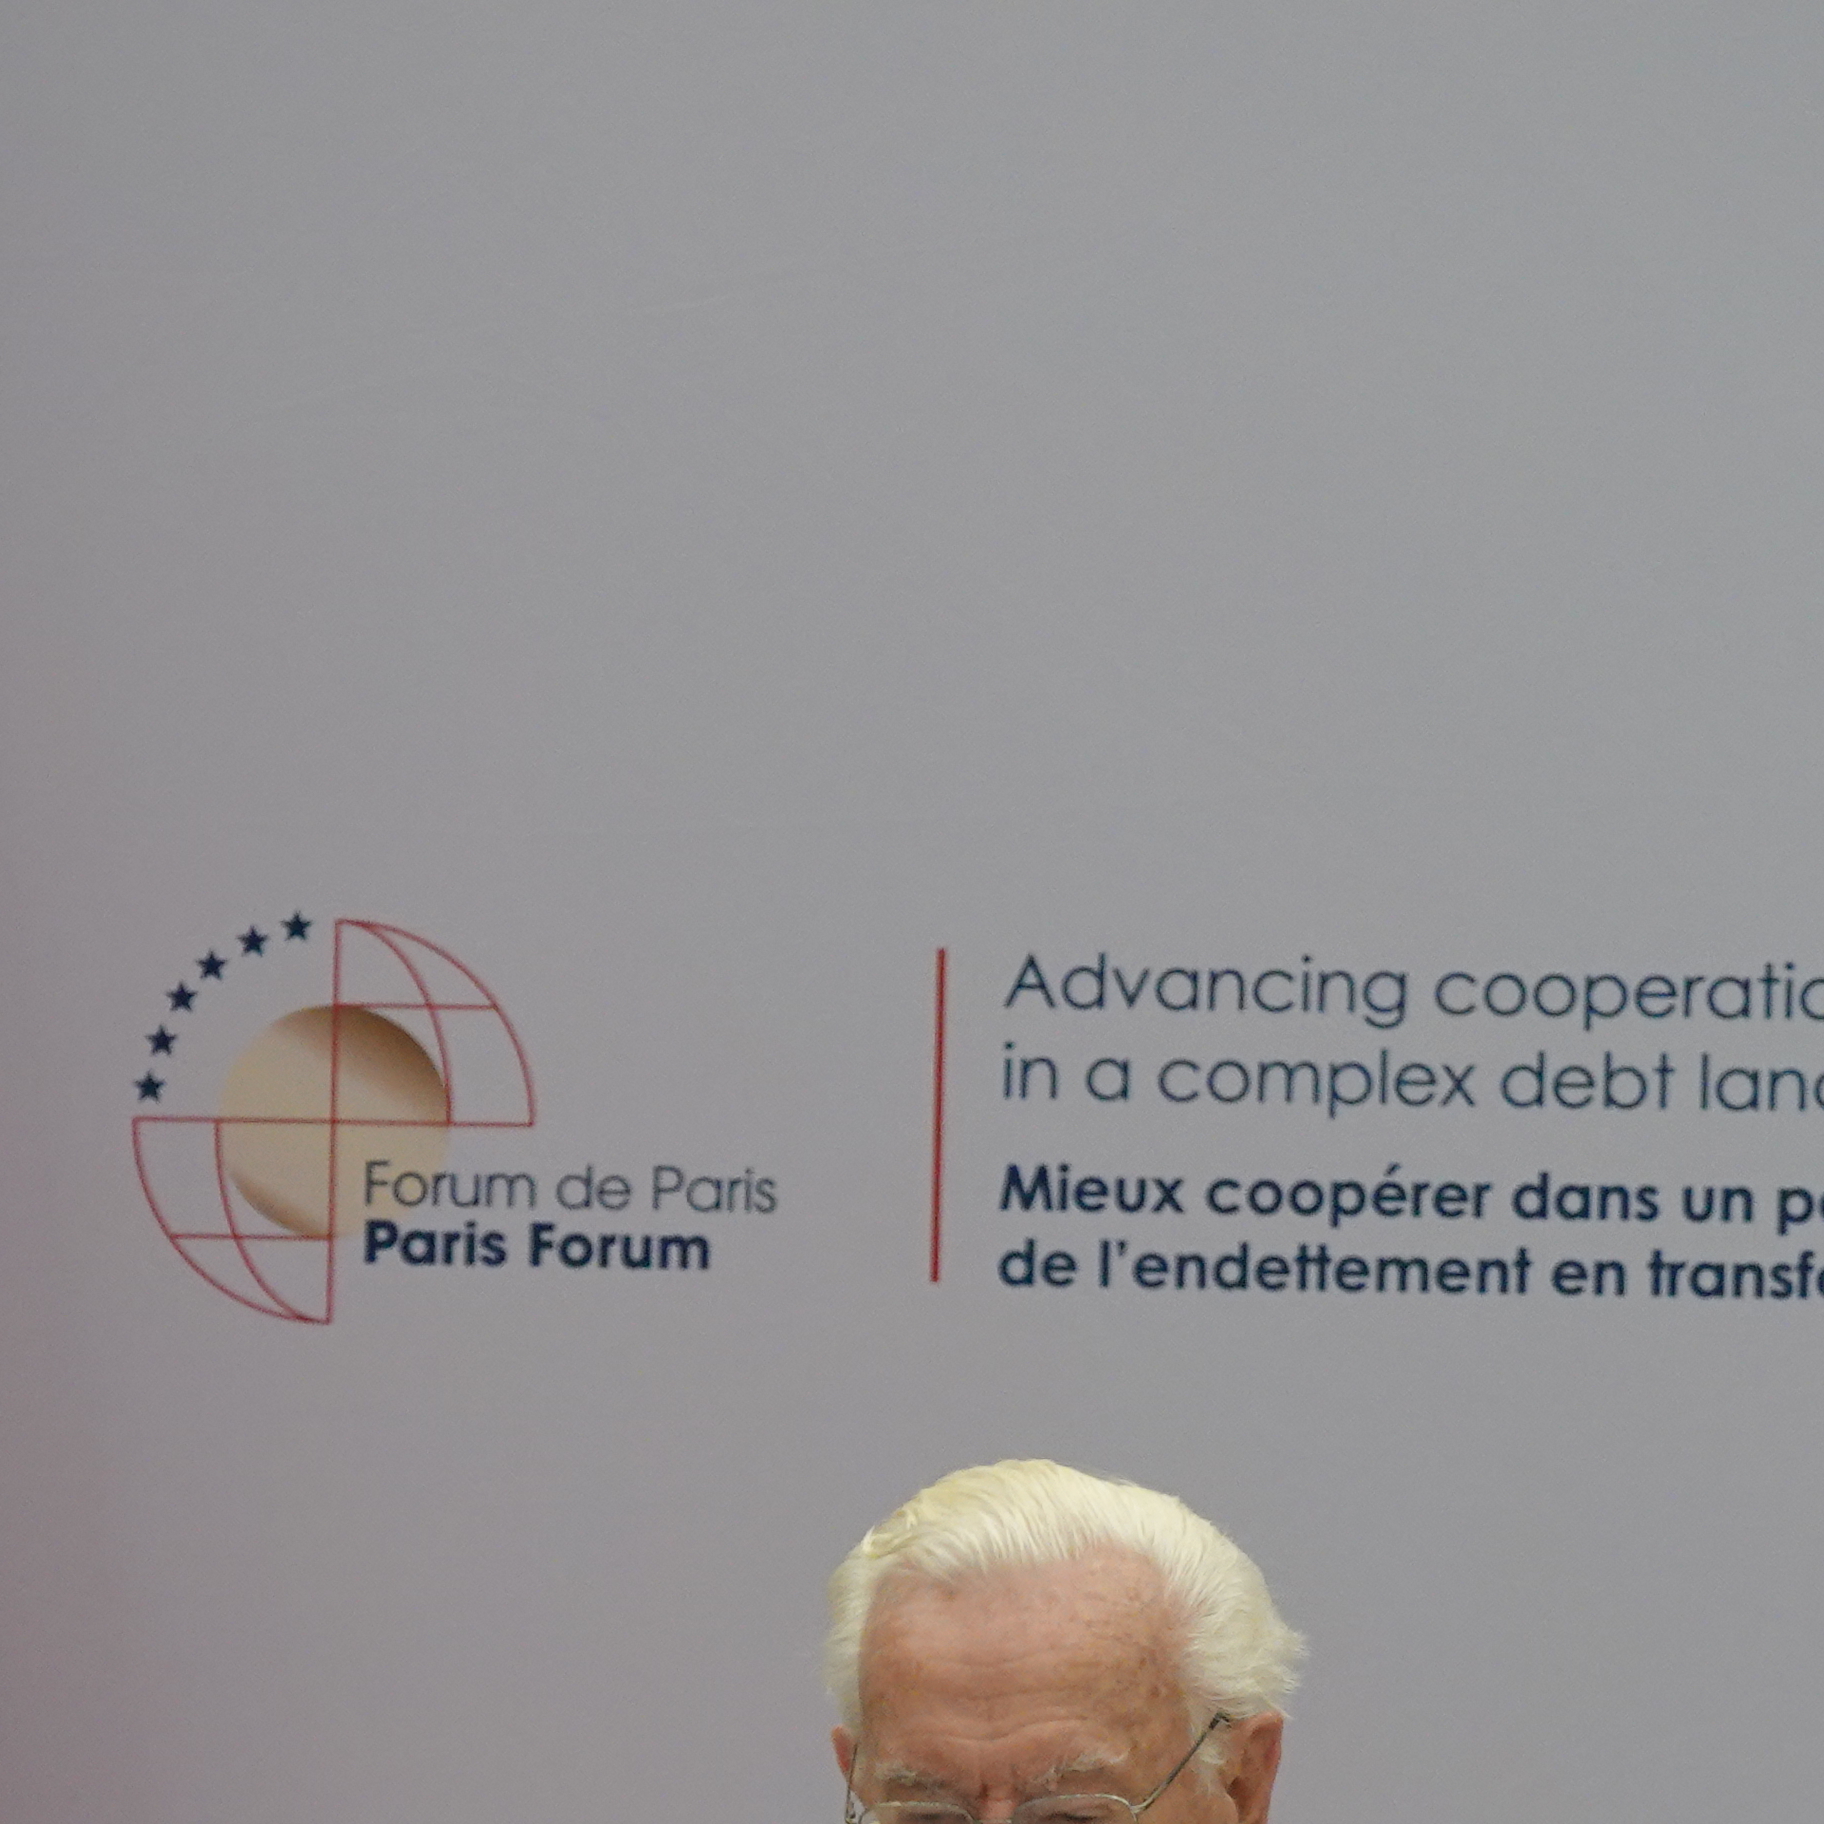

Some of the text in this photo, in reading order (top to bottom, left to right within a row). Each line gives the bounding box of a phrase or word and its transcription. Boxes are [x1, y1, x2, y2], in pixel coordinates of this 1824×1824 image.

[1003, 952, 1408, 1031] Advancing
[1002, 1040, 1059, 1101] in
[1084, 1057, 1131, 1103] a
[1157, 1047, 1476, 1120] complex
[1499, 1050, 1676, 1111] debt
[363, 1158, 778, 1215] Forum de Paris
[999, 1162, 1185, 1214] Mieux
[1205, 1162, 1493, 1229] coopérer
[1511, 1170, 1660, 1223] dans
[1682, 1185, 1755, 1224] un
[363, 1218, 711, 1271] Paris Forum
[998, 1237, 1078, 1289] de
[1099, 1238, 1533, 1296] l’endettement
[1550, 1259, 1627, 1297] en
